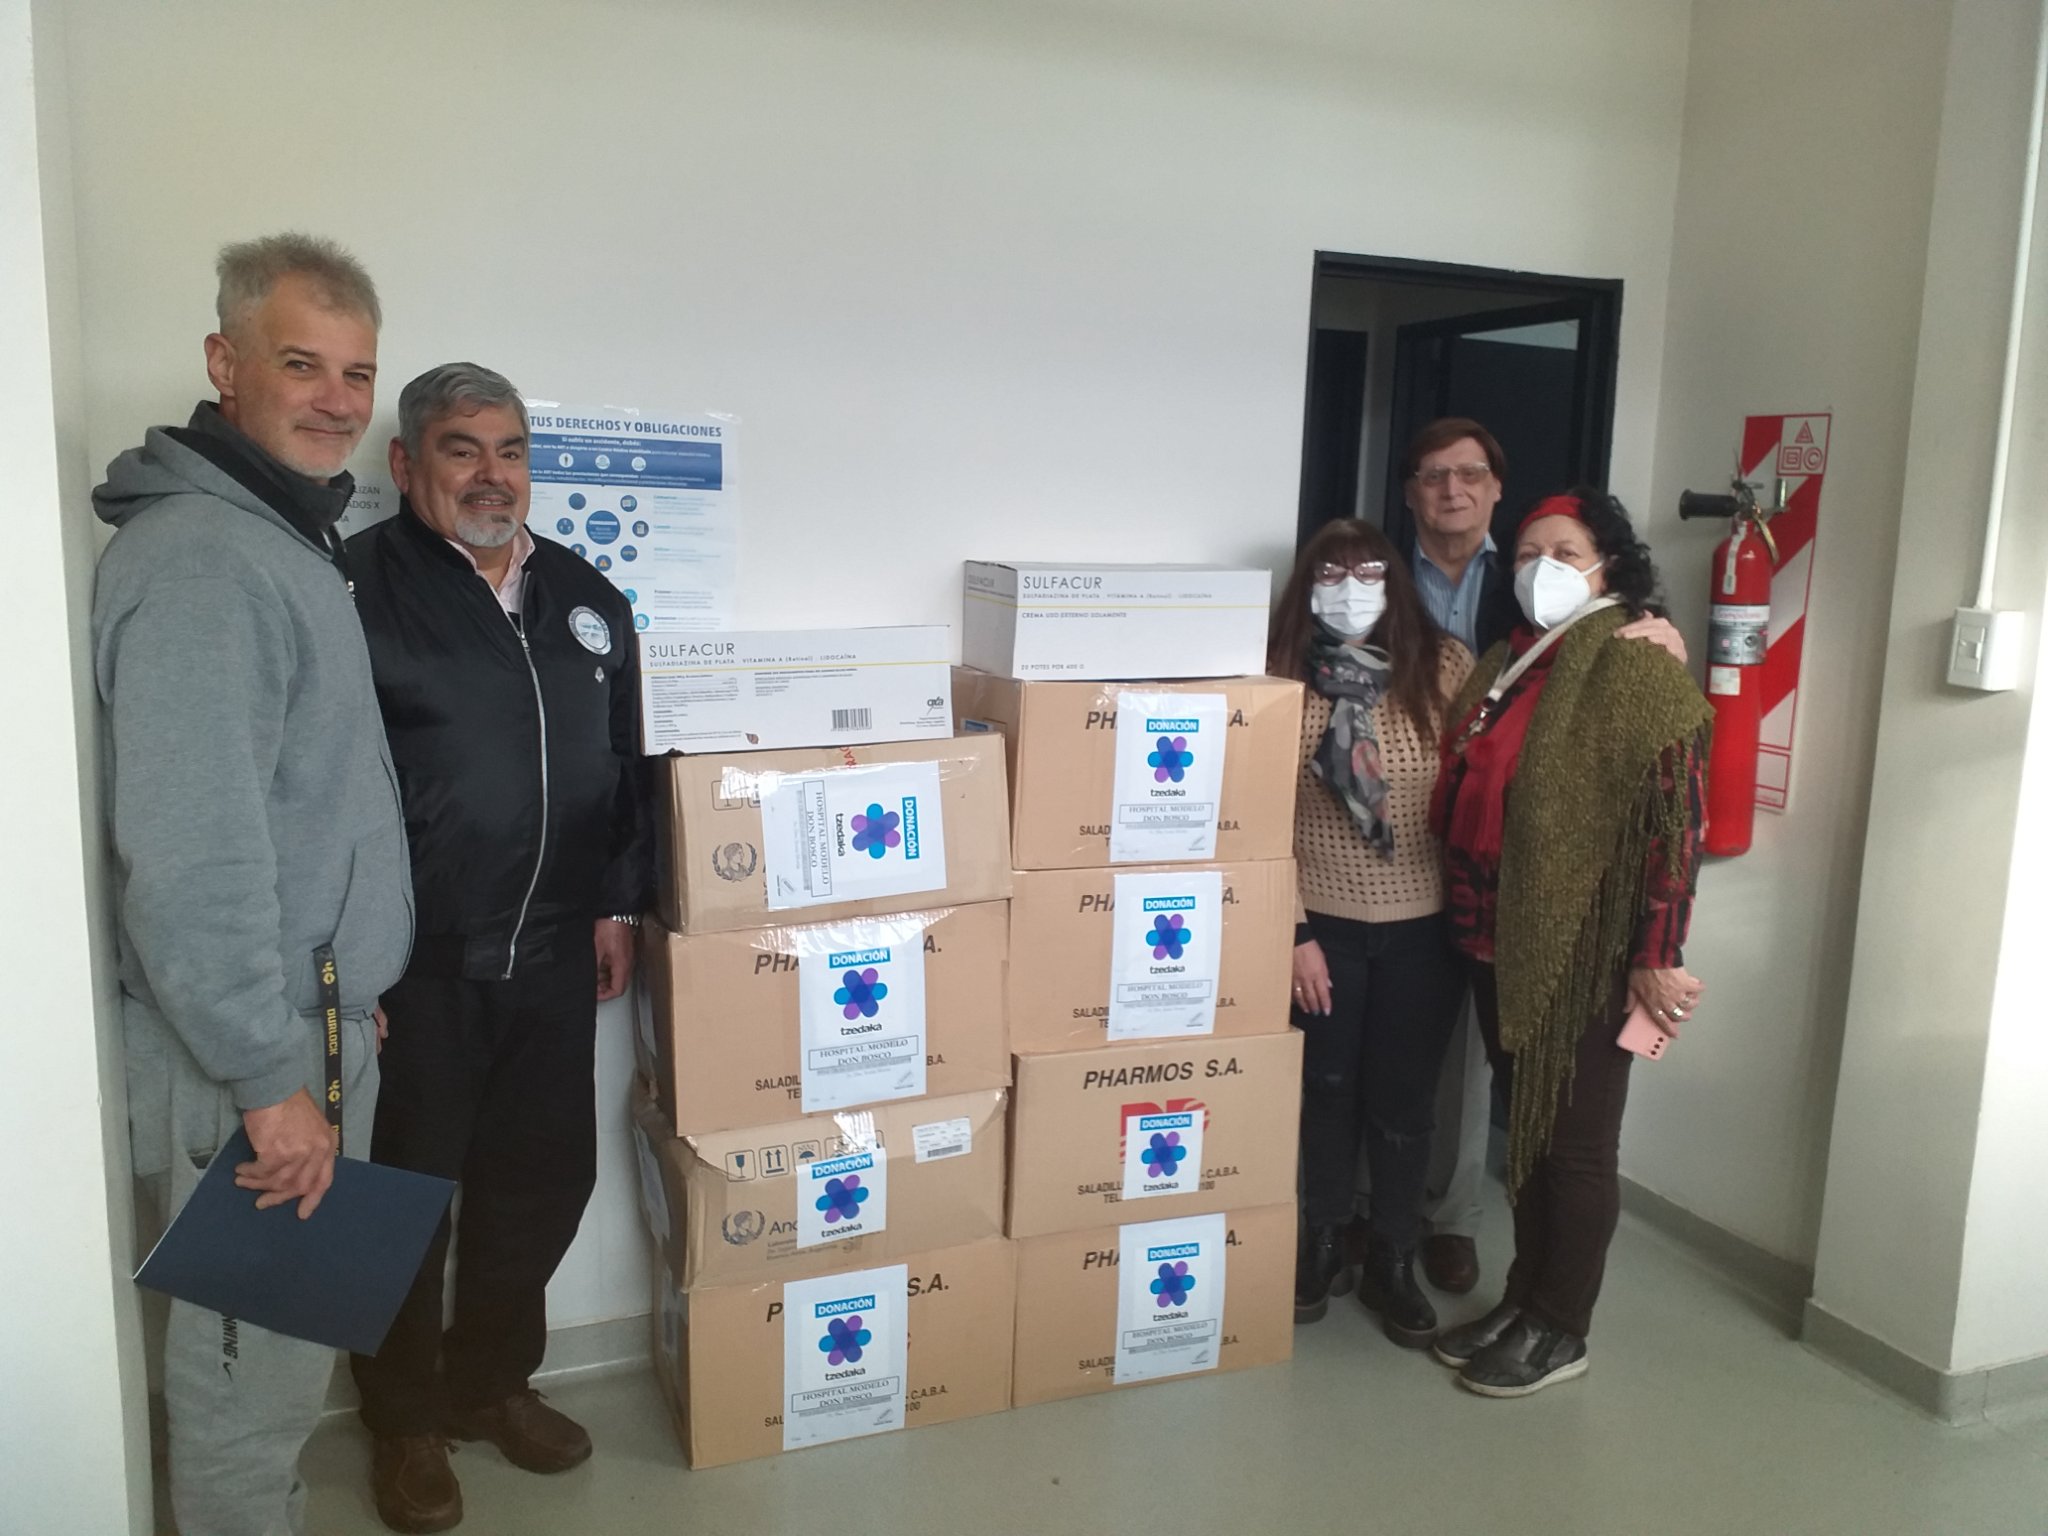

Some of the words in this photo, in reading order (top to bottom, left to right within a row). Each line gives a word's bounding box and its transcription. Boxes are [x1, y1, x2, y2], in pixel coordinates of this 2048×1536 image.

[530, 415, 552, 428] TUS
[556, 417, 621, 432] DERECHOS
[624, 421, 632, 432] Y
[634, 422, 722, 438] OBLIGACIONES
[1022, 576, 1103, 590] SULFACUR
[649, 642, 735, 658] SULFACUR
[1148, 719, 1197, 731] DONACIÓN
[1150, 788, 1186, 797] tzedaka
[816, 792, 826, 837] HOSPITAL
[1170, 804, 1205, 812] MODELO
[807, 811, 815, 833] DON
[904, 798, 918, 858] DONACIÓN
[836, 813, 846, 857] tzedaka
[810, 836, 818, 868] BOSCO
[819, 842, 830, 885] MODELO
[1146, 898, 1194, 910] DONACIÓN
[832, 950, 888, 966] DONACIÓN
[1150, 964, 1185, 974] tzedaka
[326, 1008, 338, 1056] DURLOCK
[841, 1023, 882, 1036] tzedaka
[820, 1046, 864, 1058] HOSPITAL
[868, 1039, 908, 1051] MODELO
[838, 1057, 858, 1066] DON
[861, 1051, 892, 1063] BOSCO
[1083, 1062, 1194, 1090] PHARMOS
[1205, 1058, 1243, 1078] S.A.
[1142, 1115, 1190, 1129] DONACIÓN
[814, 1156, 871, 1177] DONACIÓN
[821, 1223, 863, 1238] tzedaka
[1149, 1245, 1198, 1260] DONACIÓN
[907, 1273, 949, 1297] S.A.
[818, 1298, 873, 1316] DONACIÓN
[1153, 1311, 1188, 1322] tzedaka
[825, 1367, 866, 1381] tzedaka
[802, 1388, 847, 1401] HOSPITAL
[850, 1380, 889, 1392] MODELO
[911, 1385, 948, 1400] C.A.B.A.
[819, 1399, 840, 1408] DON
